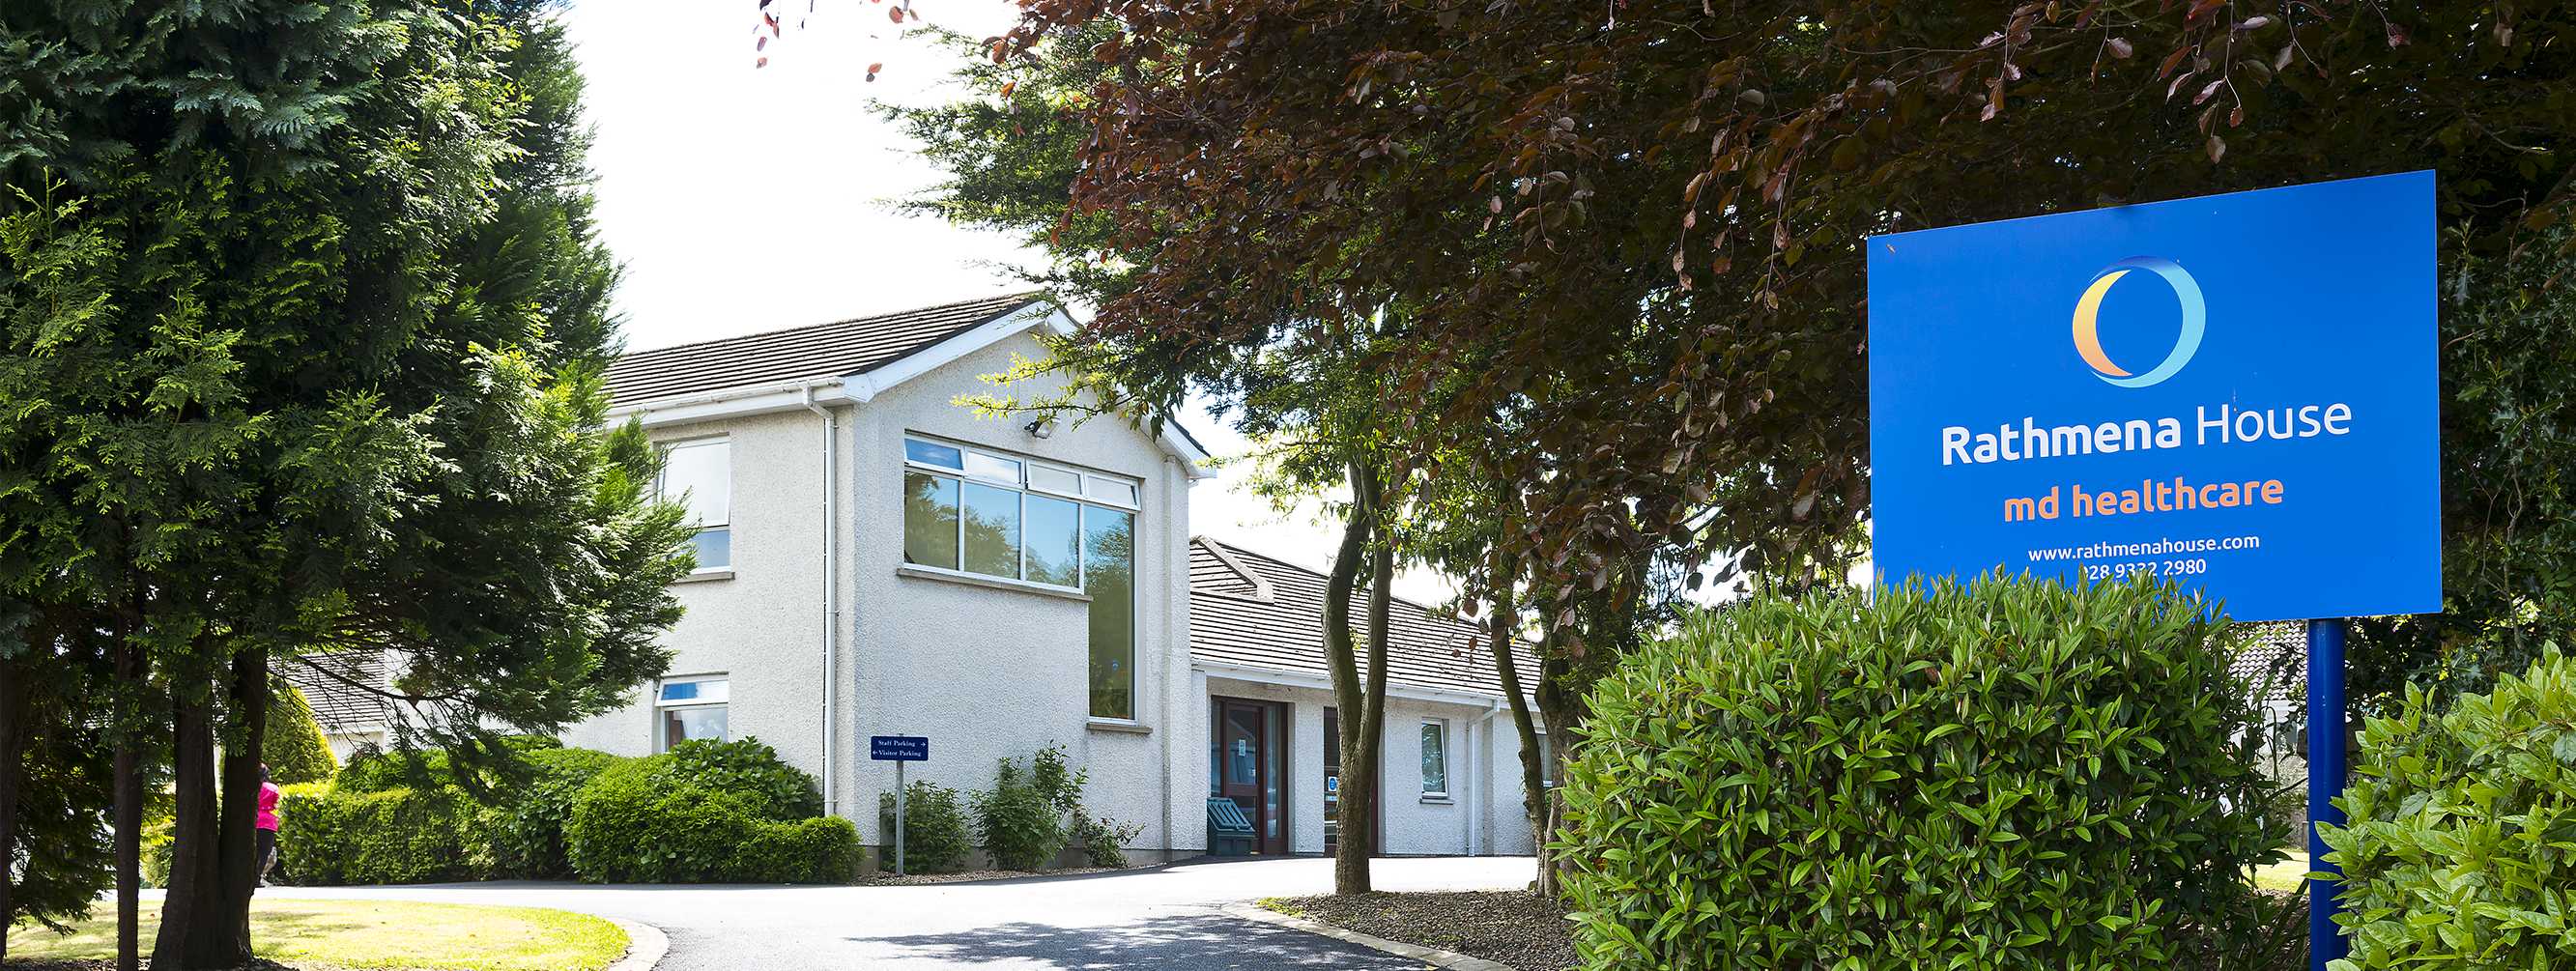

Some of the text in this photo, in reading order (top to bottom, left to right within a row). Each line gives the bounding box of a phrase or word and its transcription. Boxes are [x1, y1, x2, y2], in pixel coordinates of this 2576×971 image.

[1942, 402, 2352, 466] Rathmena House
[2004, 476, 2284, 522] md healthcare
[2028, 534, 2260, 561] www.rathmenahouse.com
[2083, 564, 2110, 580] 28
[2163, 558, 2207, 576] 2980
